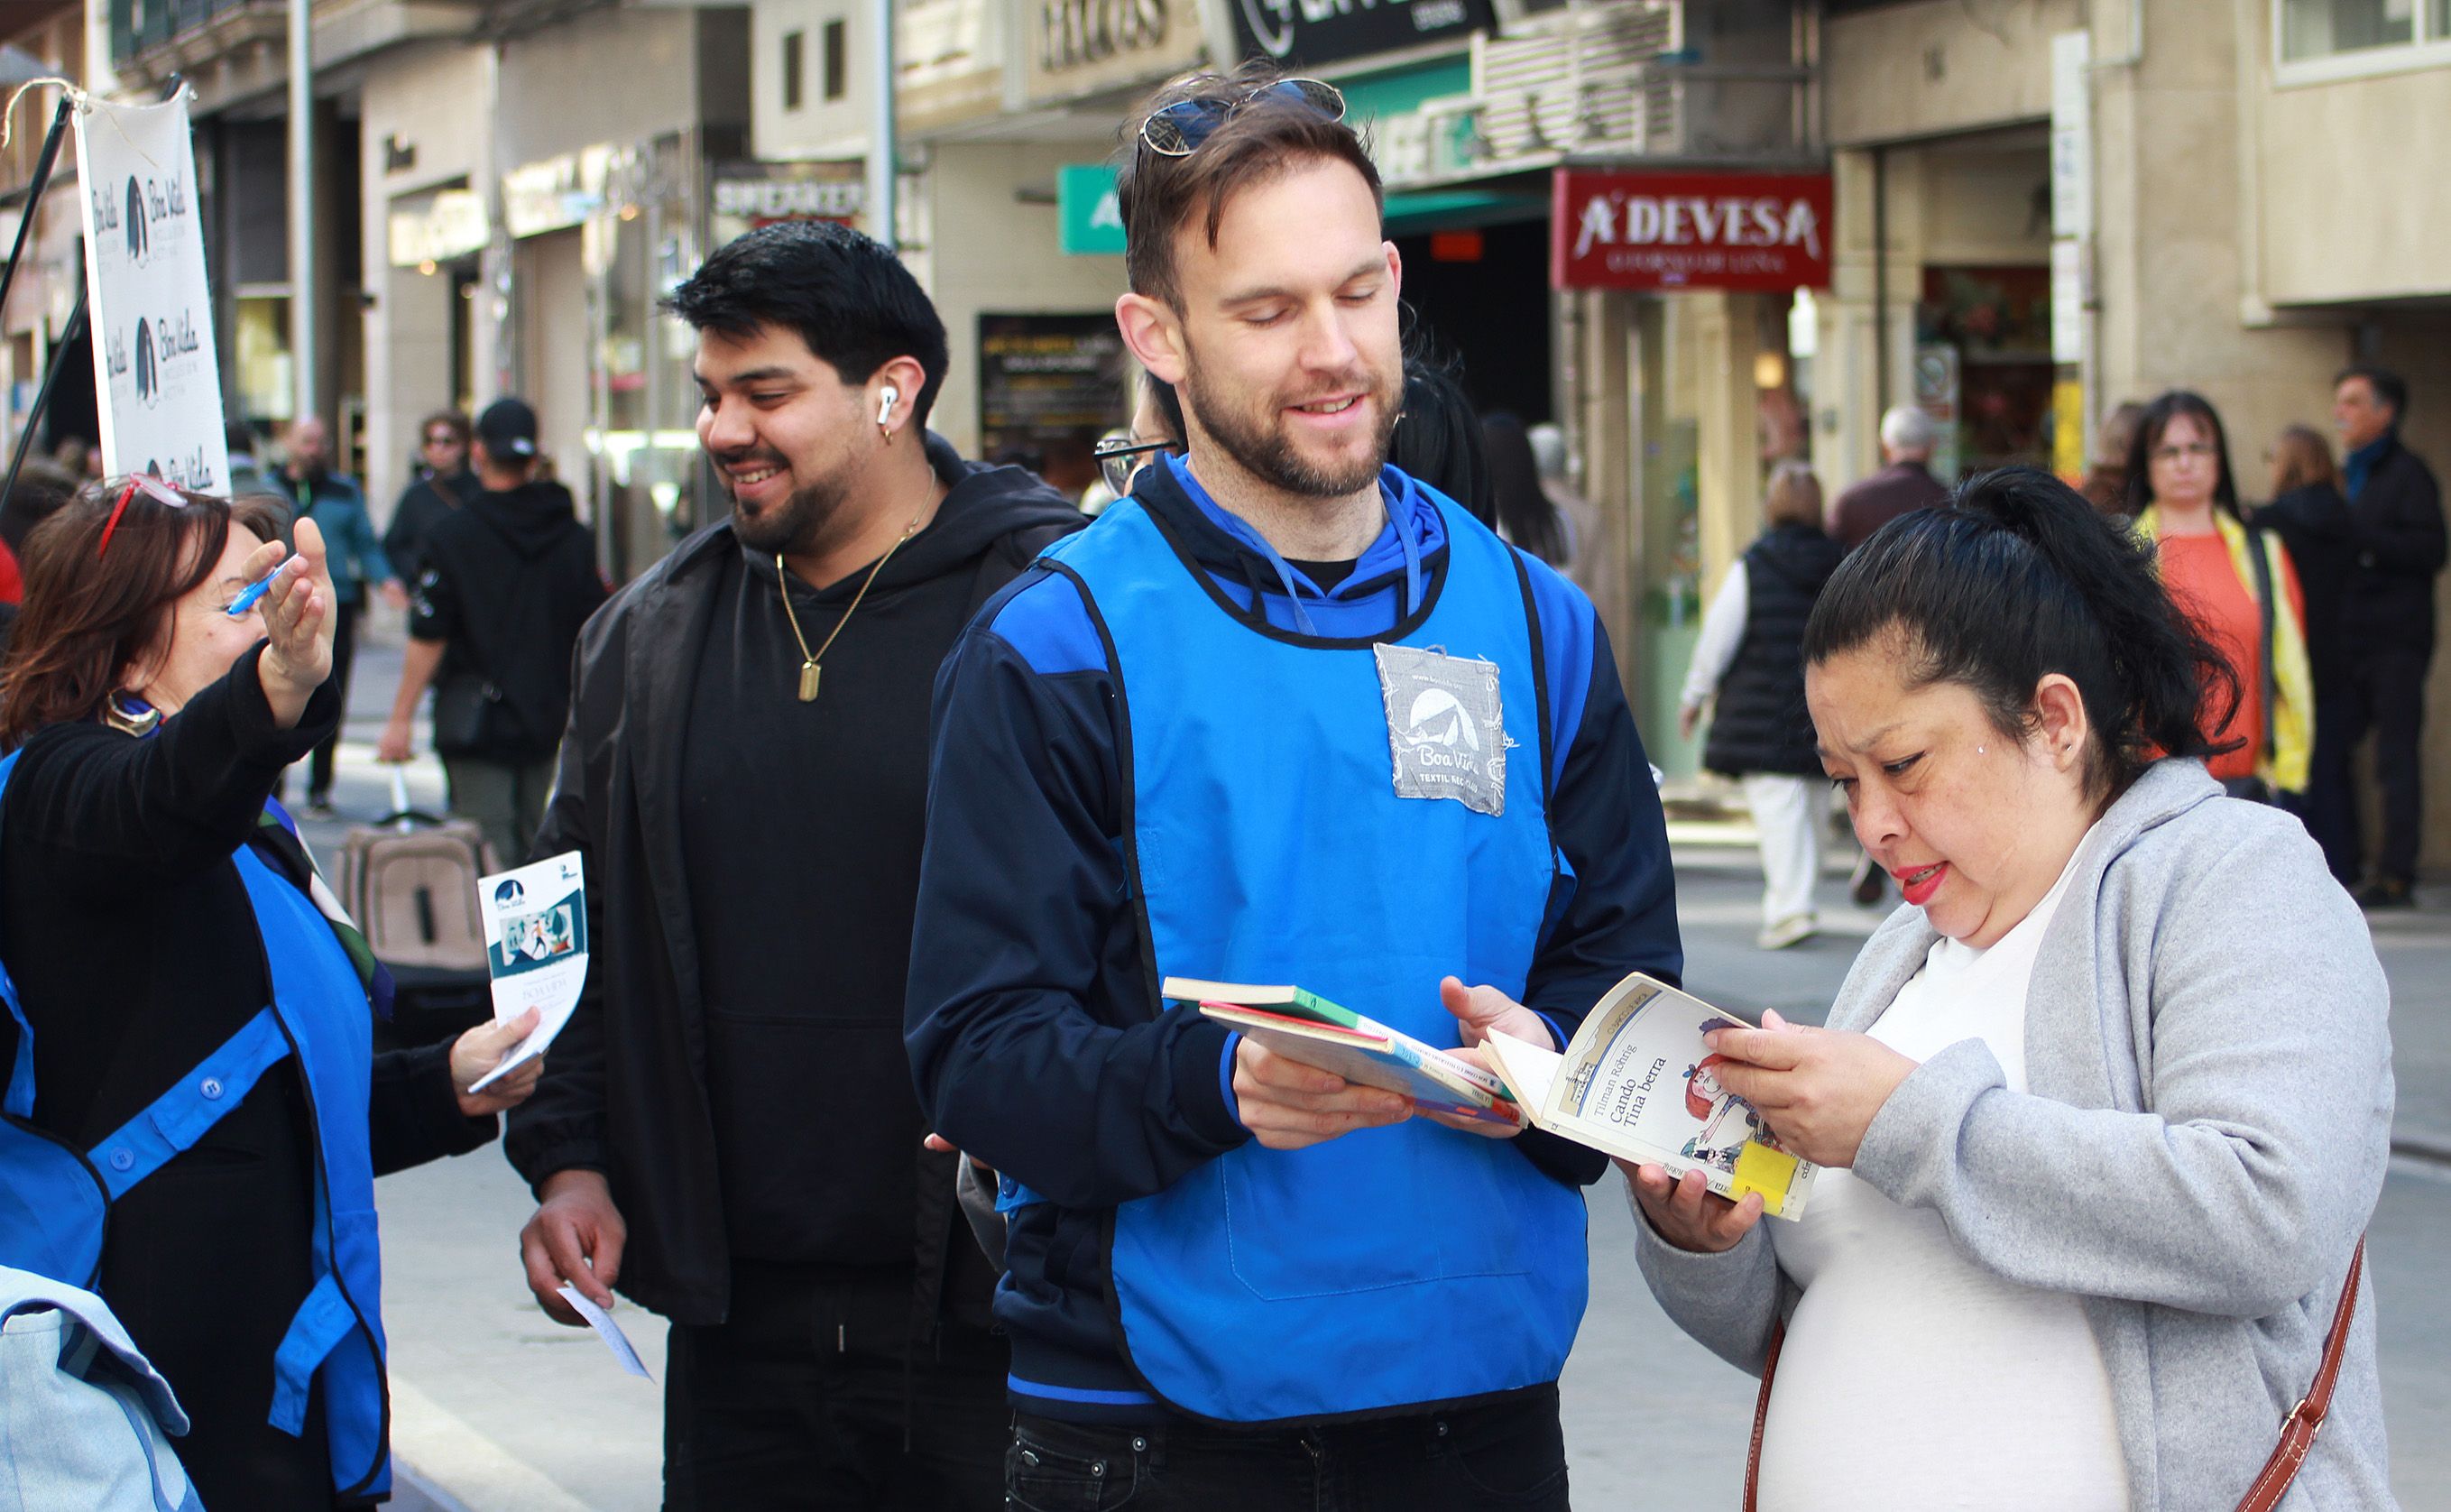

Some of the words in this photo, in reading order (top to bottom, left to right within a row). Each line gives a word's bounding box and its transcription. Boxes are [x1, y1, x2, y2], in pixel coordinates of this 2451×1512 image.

[1416, 745, 1452, 767] Boa
[1419, 772, 1450, 784] TEXTIL
[1593, 1073, 1618, 1118] Tilman
[1609, 1077, 1636, 1124] Cando
[1623, 1088, 1647, 1128] Tina
[1642, 1056, 1667, 1093] berra
